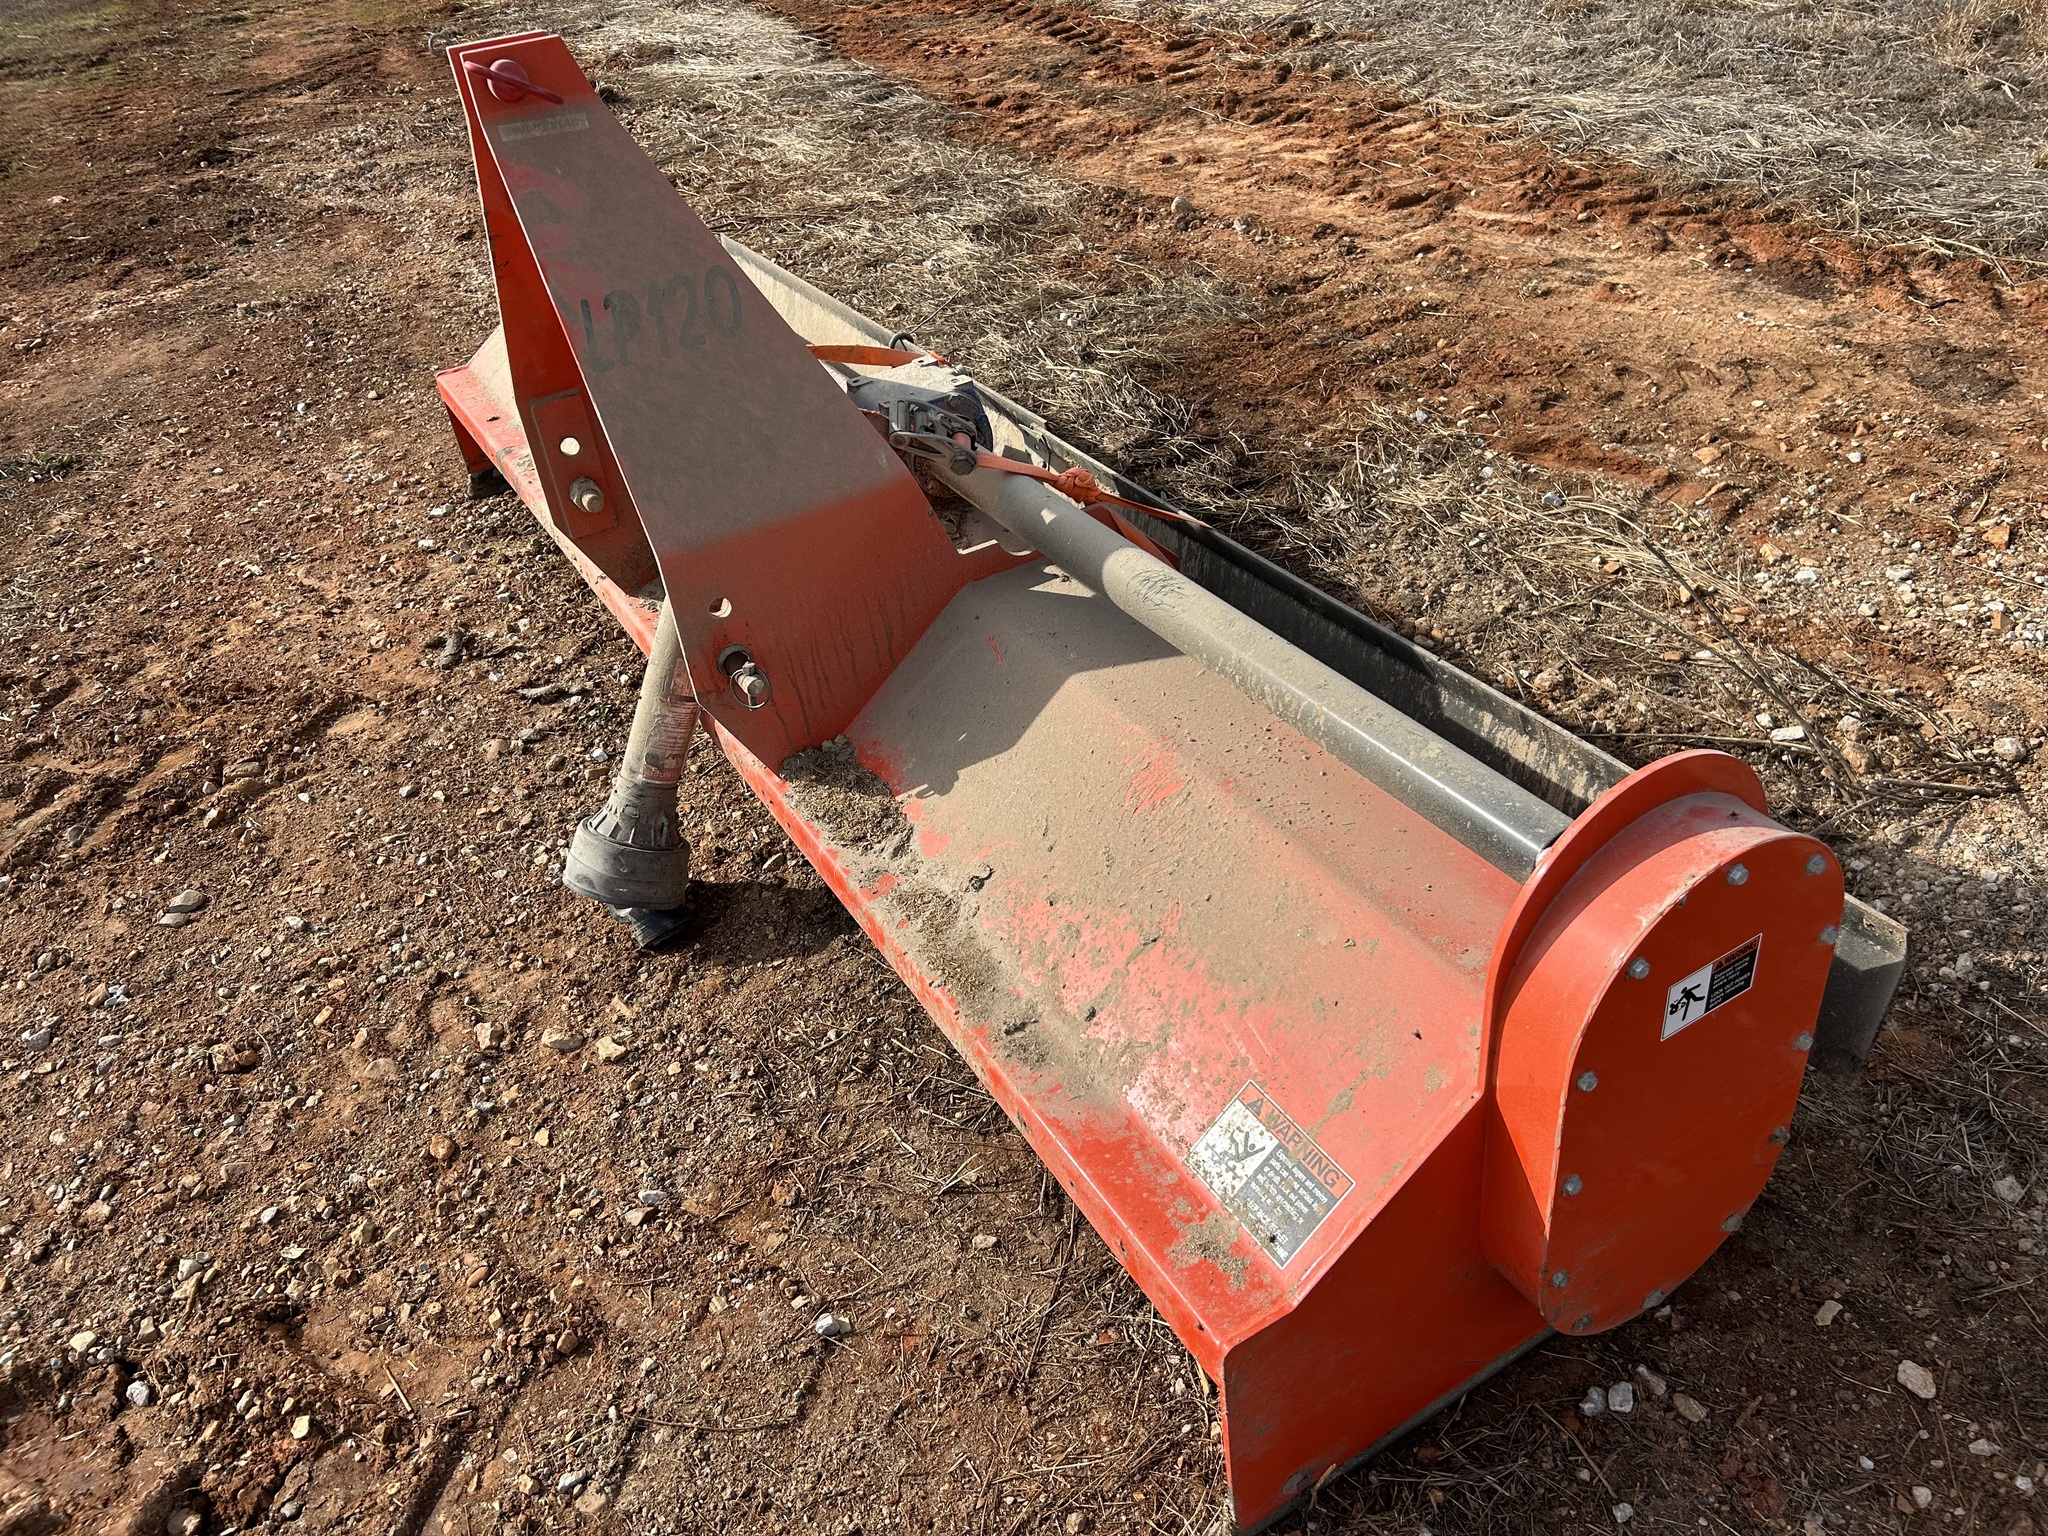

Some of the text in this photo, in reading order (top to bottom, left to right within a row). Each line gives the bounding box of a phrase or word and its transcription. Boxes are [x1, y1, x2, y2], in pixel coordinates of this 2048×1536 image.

[580, 264, 742, 372] LP120
[1725, 940, 1756, 964] WARNING
[1262, 1107, 1342, 1189] WARNING
